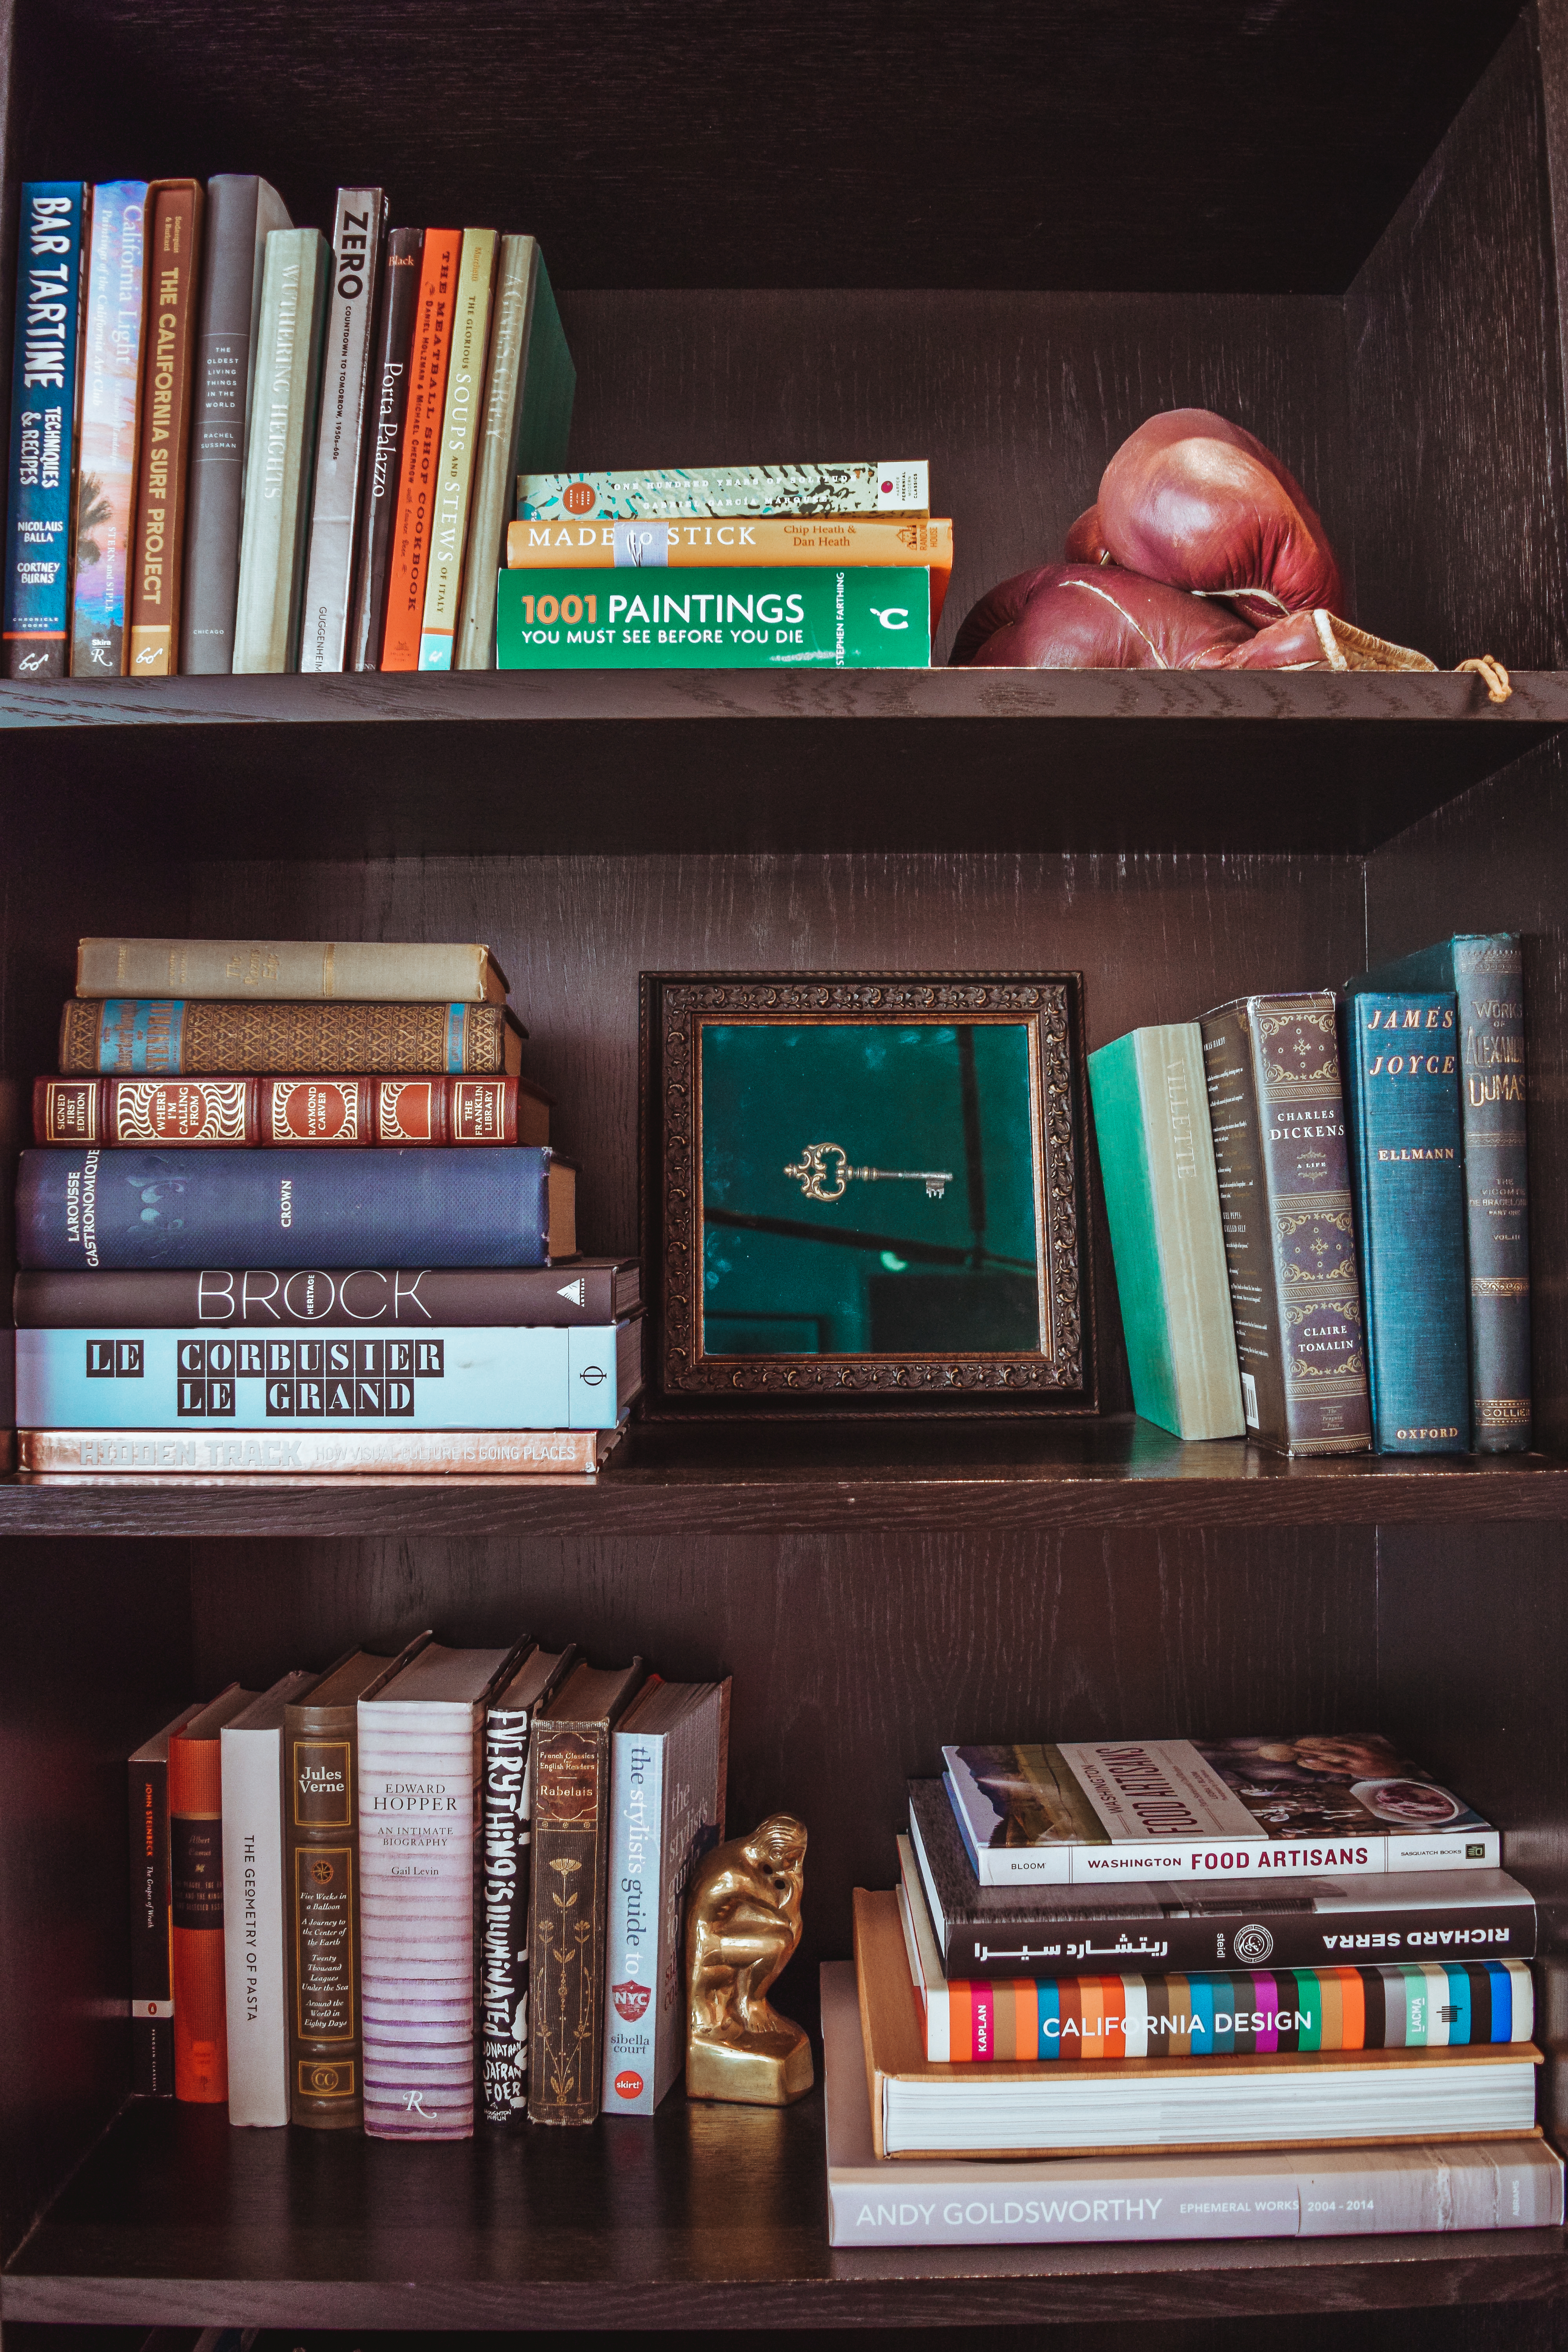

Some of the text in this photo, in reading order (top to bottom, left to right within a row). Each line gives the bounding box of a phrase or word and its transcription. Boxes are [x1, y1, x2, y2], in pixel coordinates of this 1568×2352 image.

[120, 205, 142, 302] California
[338, 210, 368, 299] ZERO
[389, 256, 414, 266] Black
[24, 197, 72, 388] BAR TARTINE
[112, 311, 137, 364] Light
[462, 319, 472, 369] GLORIOUS
[264, 265, 299, 499] WUTHERING HEIGHTS
[449, 374, 471, 450] SOUPS
[143, 268, 178, 604] THE CALIFORNIA SURF PROJECT
[373, 363, 403, 497] Porta Palazzo
[19, 412, 41, 486] & RECIPES
[41, 406, 62, 489] TECHNIQUES
[18, 521, 63, 532] NICOLAUS
[437, 482, 460, 562] STEWS
[528, 526, 756, 546] MADE to STICK
[24, 532, 53, 543] BALLA
[793, 537, 850, 546] Dan Heath
[17, 562, 60, 573] CORTNEY
[21, 573, 54, 584] BURNS
[440, 568, 448, 580] OF
[522, 594, 804, 624] 1001 PAINTINGS
[836, 572, 845, 665] STEPHEN FARTHING
[315, 607, 327, 672] GUGGENHEIM
[522, 630, 803, 644] YOU MUST SEE BEFORE YOU DIE
[1368, 1009, 1453, 1029] JAMES
[1370, 1056, 1455, 1075] JOYCE
[1468, 1073, 1525, 1107] DUMAS
[157, 1092, 166, 1131] WHERE
[180, 1087, 188, 1134] CALLING
[191, 1095, 199, 1125] FROM
[485, 1091, 493, 1131] LIBRARY
[1167, 1059, 1196, 1179] VILLETTE
[1278, 1110, 1334, 1122] CHARLES
[1270, 1125, 1344, 1140] DICKENS
[1379, 1149, 1454, 1161] ELLMANN
[68, 1172, 80, 1242] LAROUSSE
[80, 1149, 100, 1267] GASTRONOMIQUE
[281, 1180, 291, 1228] CROWN
[198, 1270, 432, 1320] BROCK
[1304, 1325, 1347, 1336] CLAIRE
[90, 1343, 441, 1371] LE CORBUSIER
[1298, 1340, 1353, 1352] TOMALIN
[181, 1383, 411, 1410] LE GRAND
[1397, 1428, 1459, 1440] OXFORD
[80, 1440, 575, 1466] HIDDEN TRACK HOW VISUAL CULTURE IS GOING PLACES
[301, 1767, 341, 1780] Jules
[1096, 1747, 1177, 1797] ARTISANS
[299, 1780, 344, 1793] Verne
[386, 1784, 445, 1793] EDWARD
[541, 1785, 593, 1796] Rabelais
[1082, 1764, 1123, 1815] WASHINGTON
[374, 1797, 457, 1810] HOPPER
[1132, 1800, 1204, 1834] FOOD
[392, 1866, 439, 1875] Gail Levin
[622, 1747, 651, 1974] the stylist's guide to
[1088, 1858, 1181, 1869] WASHINGTON
[1192, 1852, 1249, 1870] FOOD
[1258, 1848, 1368, 1868] ARTISANS
[244, 1835, 257, 2021] THE GEOMETRY OF PASTA
[1323, 1928, 1510, 1949] RICHARD SERRA
[975, 1934, 1168, 1961] ريتشارد سيرا
[615, 1992, 647, 2005] NYC
[978, 2005, 987, 2052] KAPLAN
[1043, 2011, 1312, 2038] CALIFORNIA DESIGN
[611, 2034, 650, 2045] sibella
[614, 2045, 646, 2054] court
[857, 2198, 1374, 2227] ANDY GOLDSWORTHY EPHEMERAL WORKS 2004 2014
